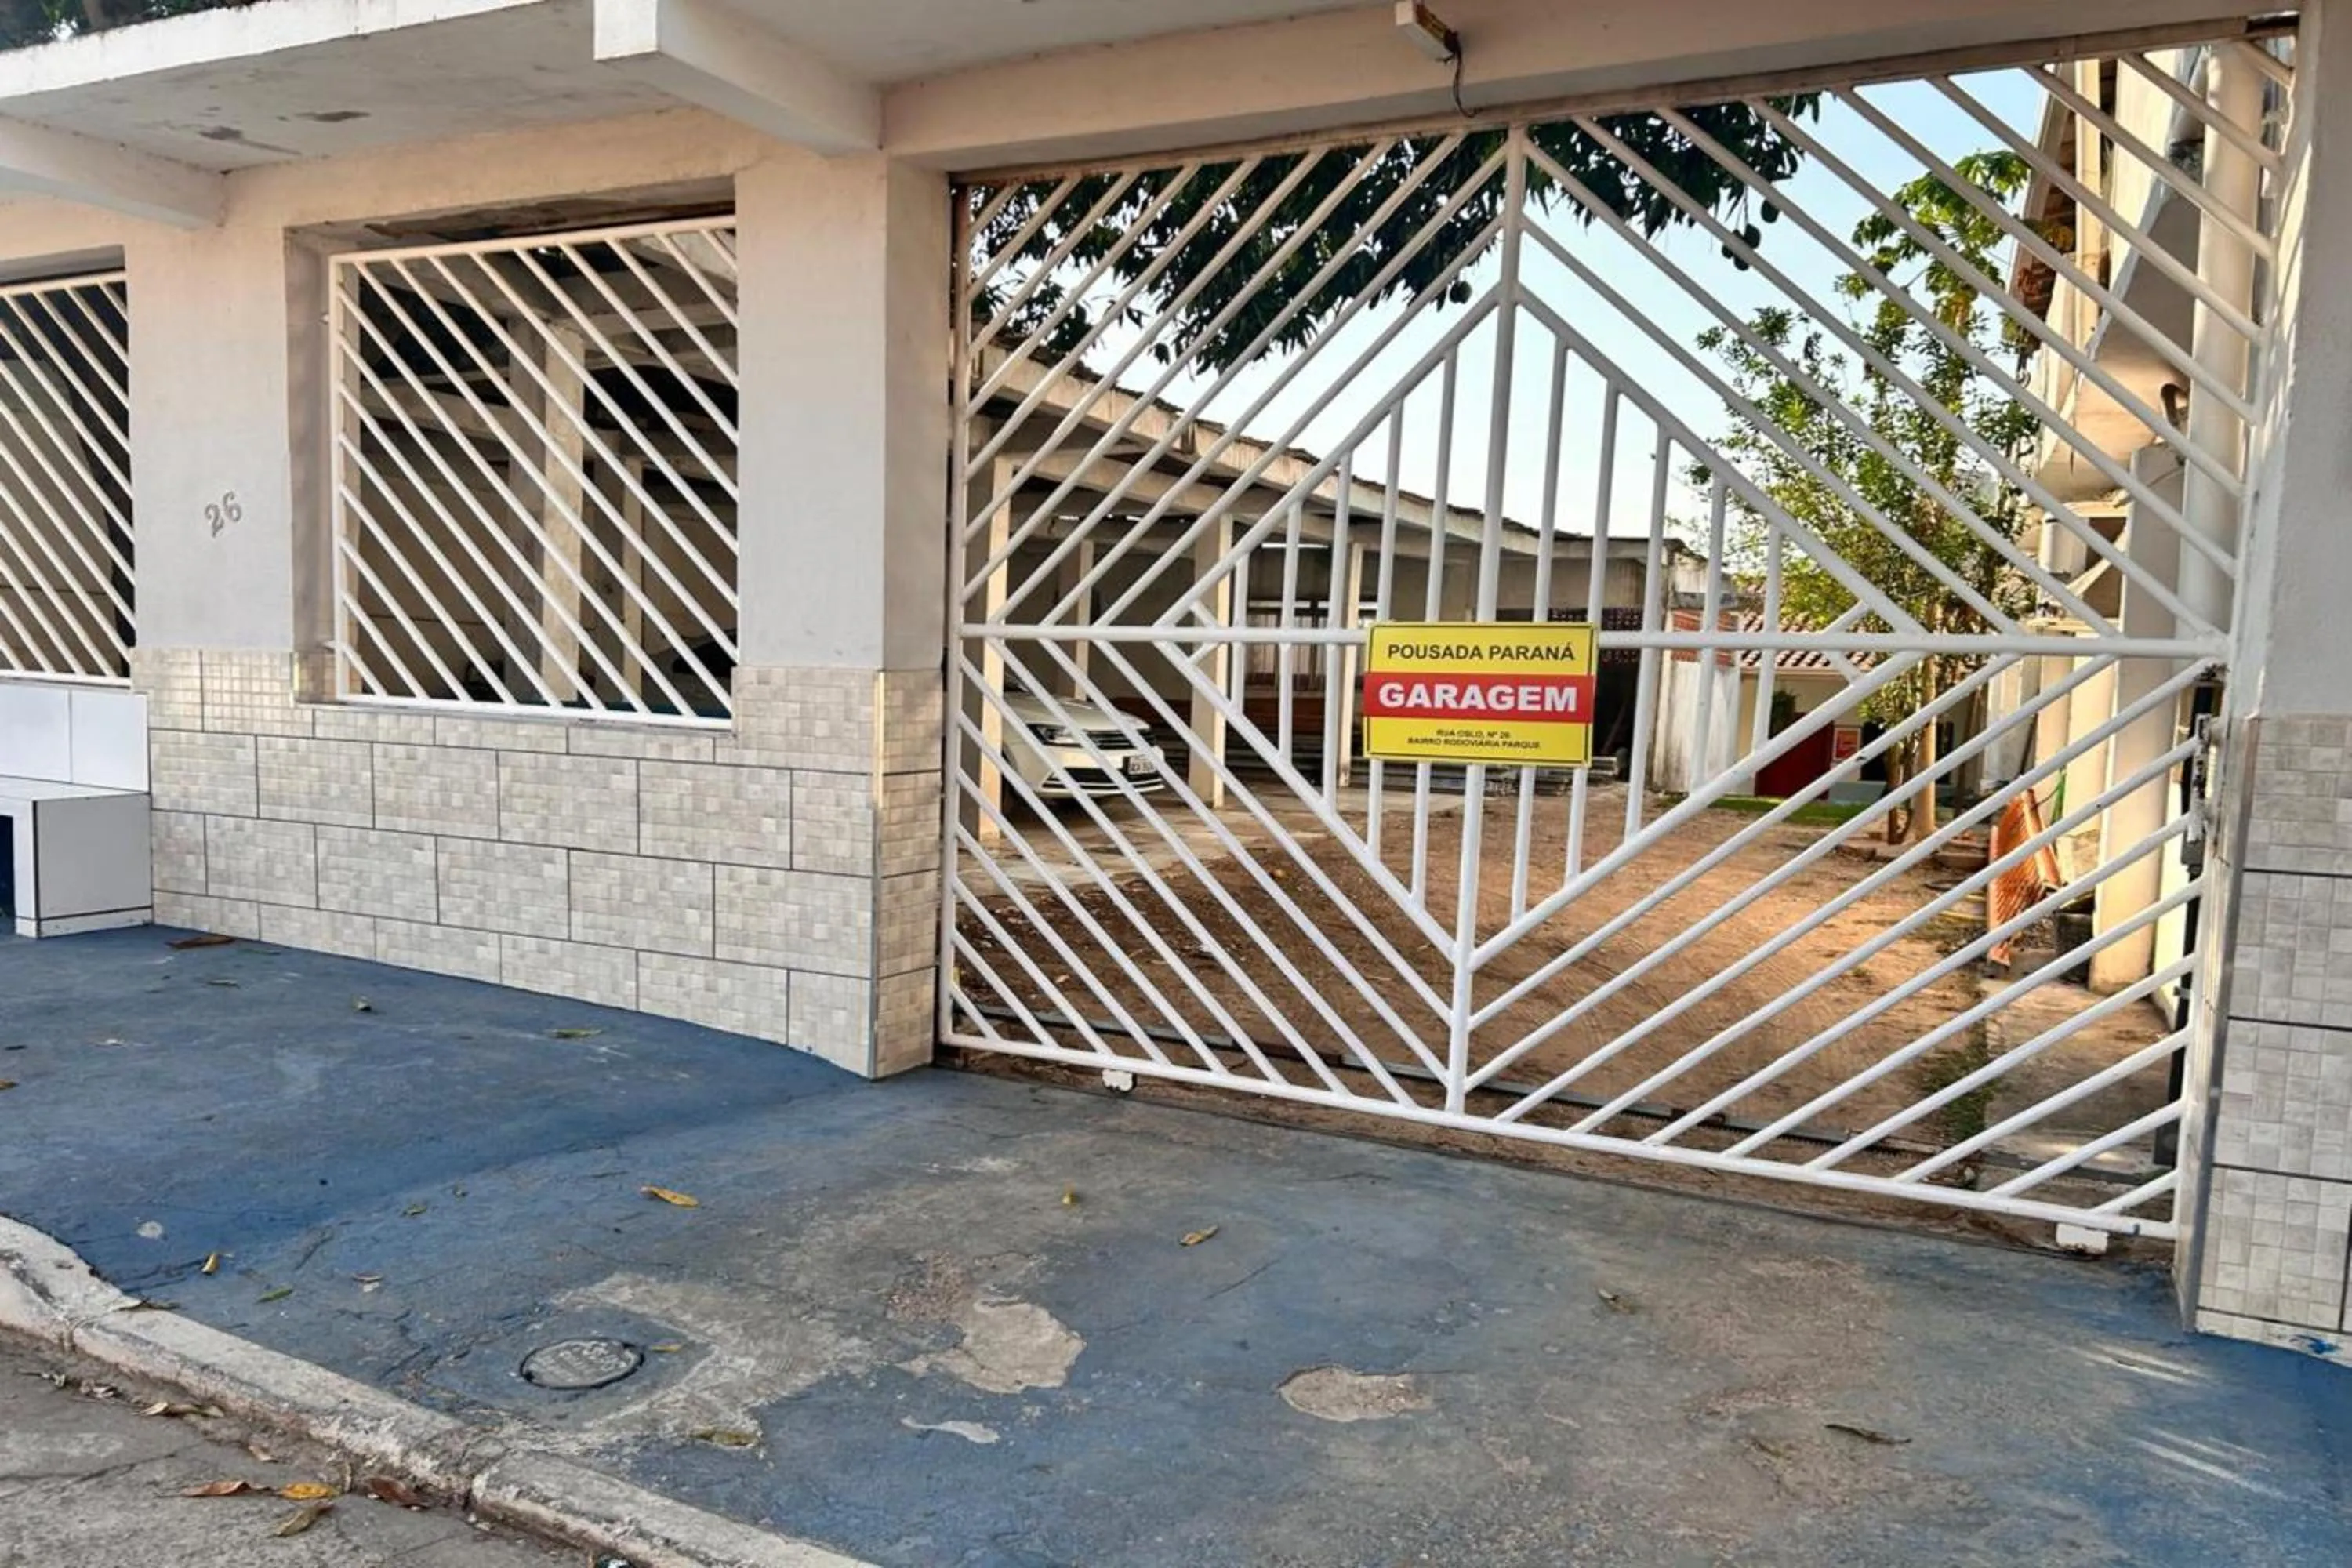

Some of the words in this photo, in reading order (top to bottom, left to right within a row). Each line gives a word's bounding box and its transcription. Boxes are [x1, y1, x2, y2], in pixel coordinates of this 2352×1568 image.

[205, 491, 242, 539] 26
[1388, 644, 1483, 659] POUSADA
[1490, 642, 1575, 661] PARANÁ
[1378, 681, 1577, 713] GARAGEM
[1502, 740, 1541, 749] PARQUE
